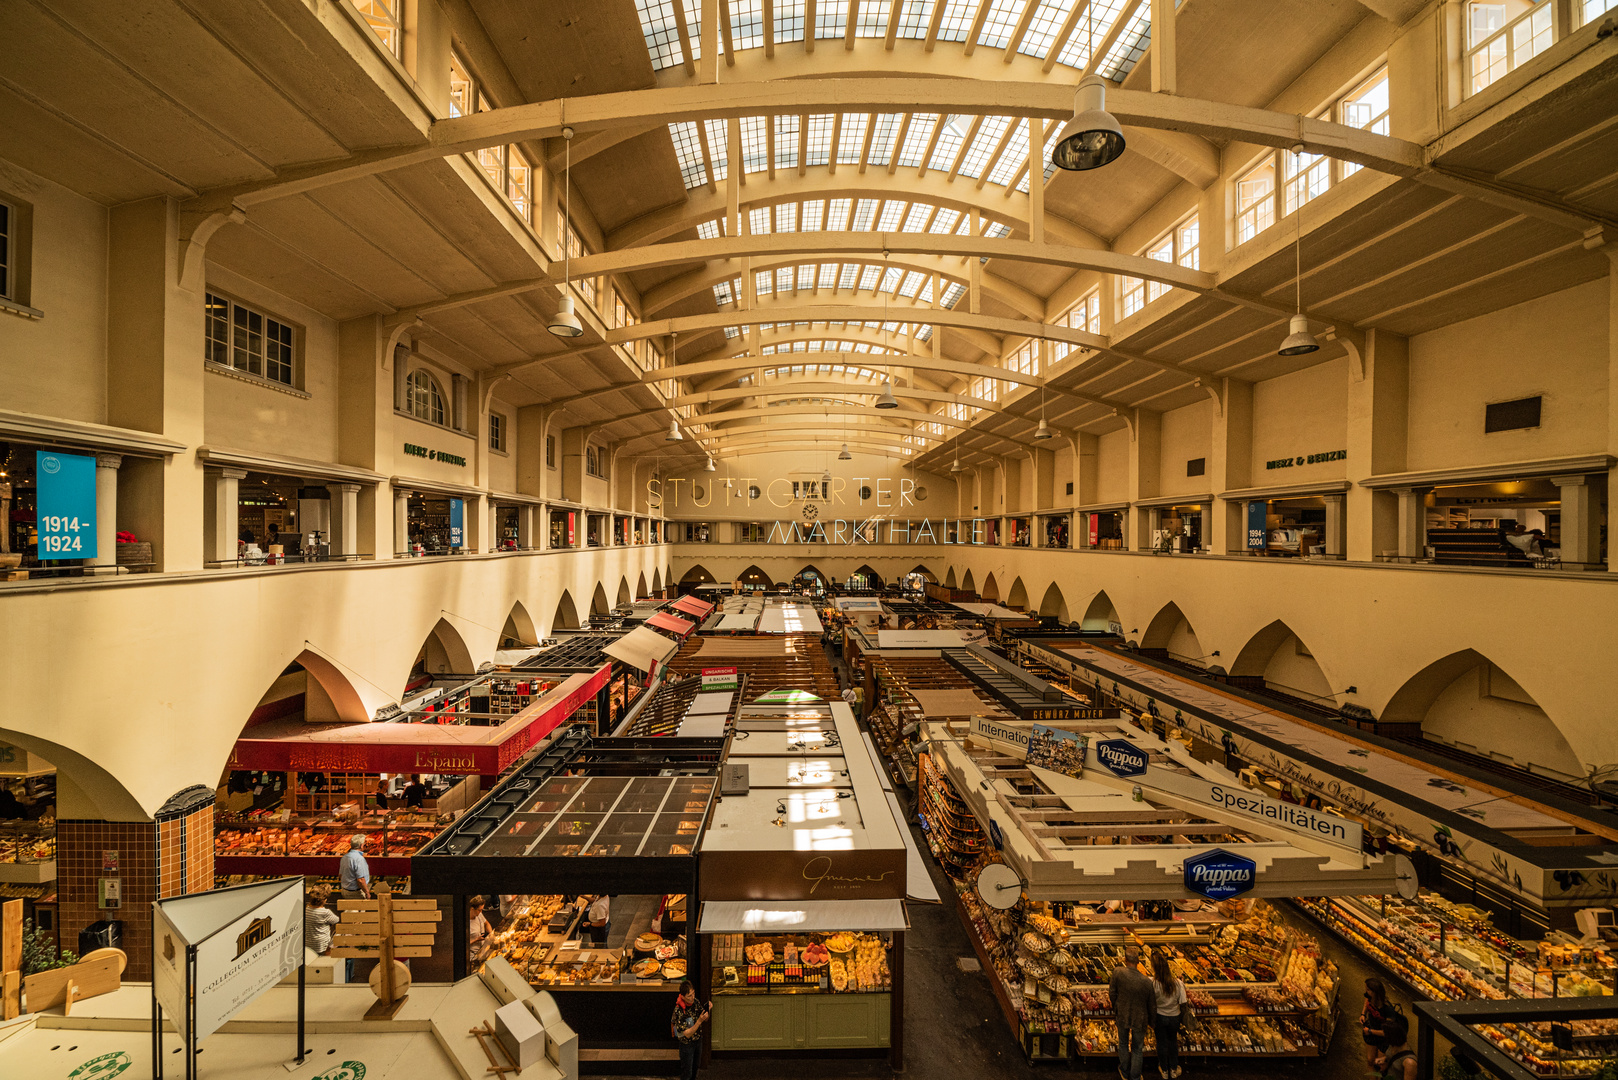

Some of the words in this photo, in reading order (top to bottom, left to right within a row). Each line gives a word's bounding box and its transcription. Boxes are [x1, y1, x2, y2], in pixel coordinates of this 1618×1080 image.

[404, 443, 428, 458] MERZ
[429, 449, 436, 460] &
[1266, 458, 1293, 470] MERZ
[1296, 456, 1305, 466] &
[645, 477, 914, 508] STUTTGARTER
[766, 517, 986, 545] MARKTHALLE
[42, 536, 82, 552] 1924
[1033, 708, 1069, 720] GEWÜRZ
[1074, 709, 1103, 719] MAYER
[1100, 744, 1143, 768] Pappas
[978, 720, 1031, 745] Internatio
[1211, 786, 1345, 840] Spezialitäten
[1193, 864, 1250, 886] Pappas
[202, 958, 250, 995] COLLEGIUM
[252, 925, 299, 959] WIRTEMBERG
